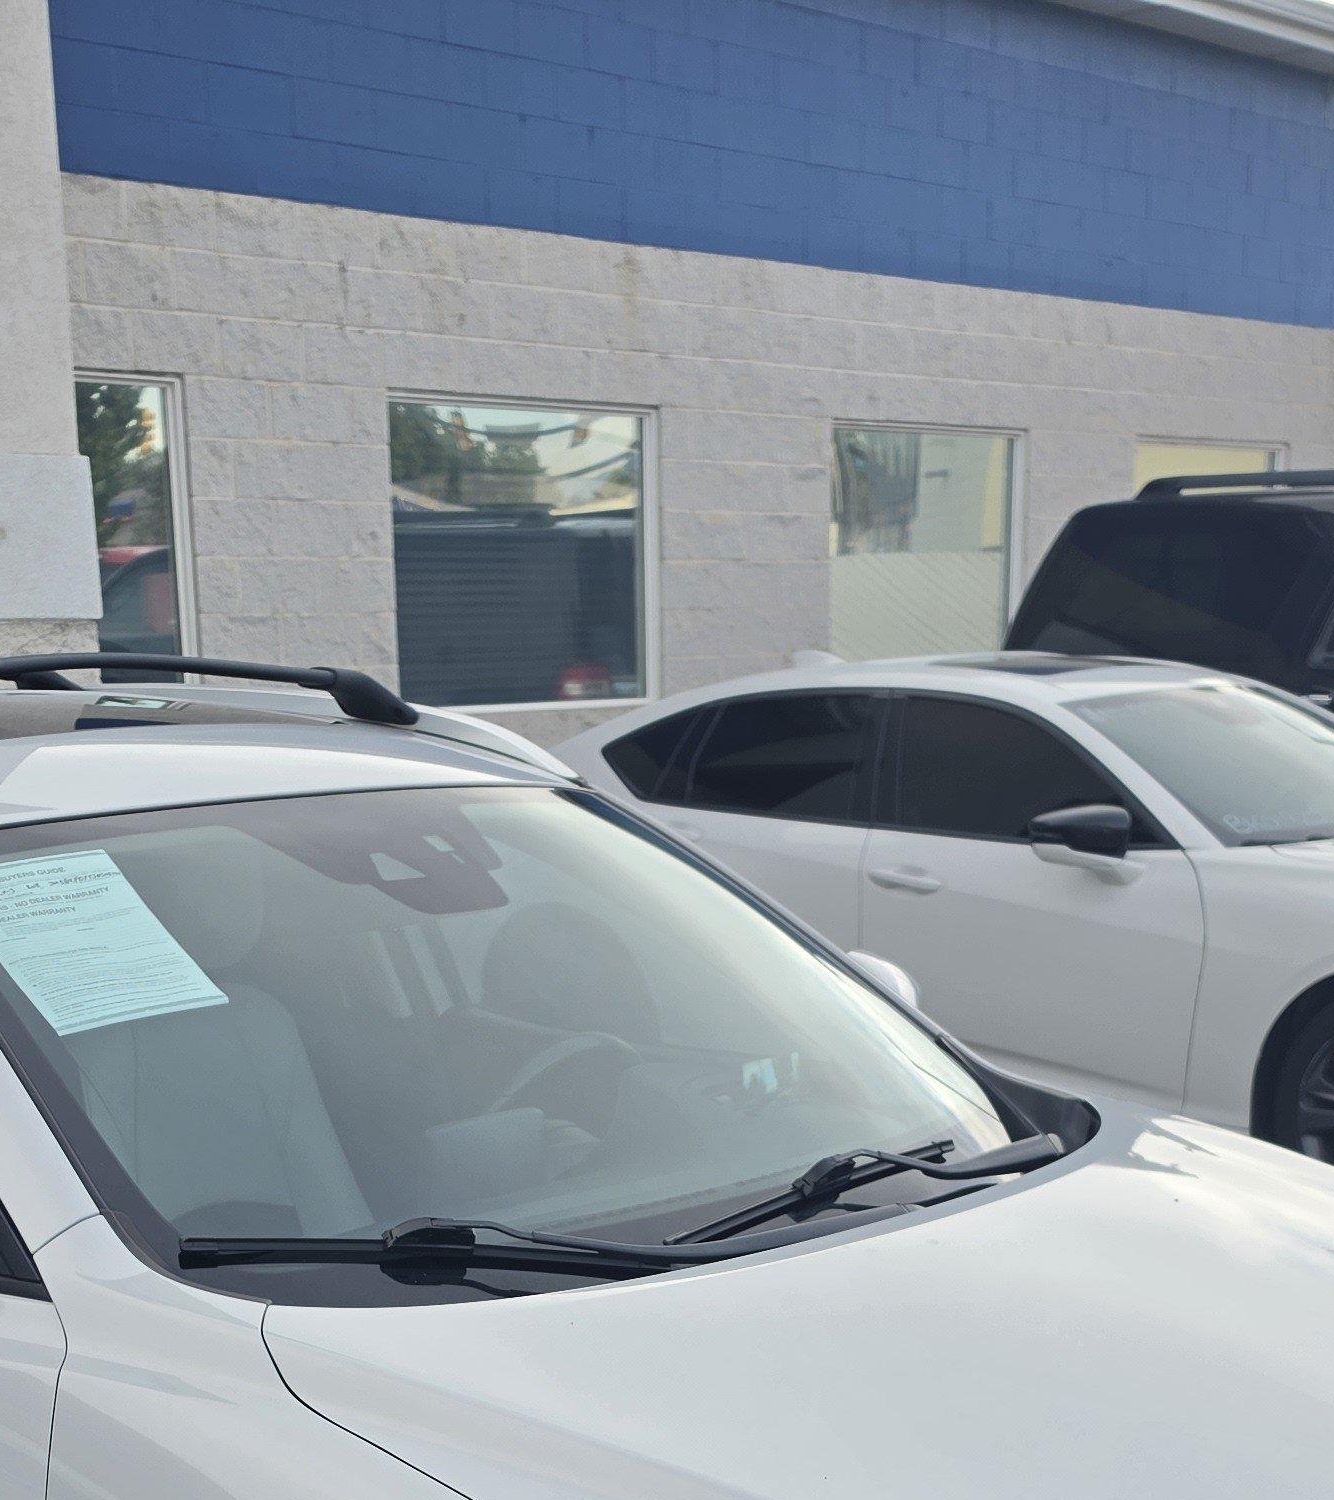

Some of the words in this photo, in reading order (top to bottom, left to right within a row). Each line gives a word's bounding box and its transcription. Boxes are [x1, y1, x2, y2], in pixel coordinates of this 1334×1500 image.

[36, 866, 66, 876] GUIDE
[30, 894, 62, 906] DEALER
[63, 886, 109, 900] WARRANTY
[30, 906, 76, 918] WARRANTY
